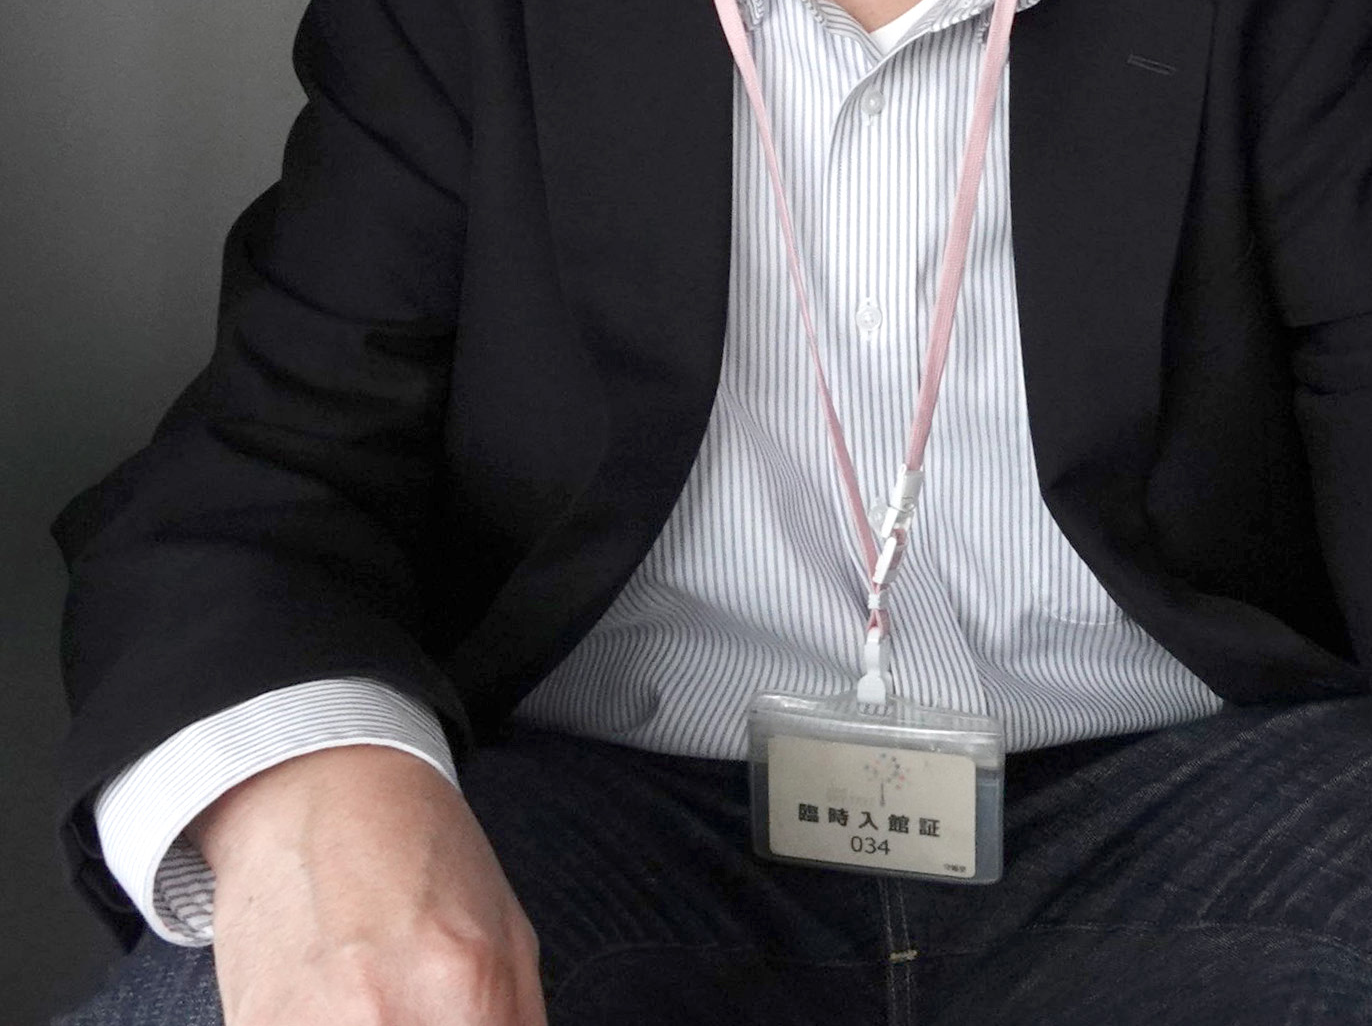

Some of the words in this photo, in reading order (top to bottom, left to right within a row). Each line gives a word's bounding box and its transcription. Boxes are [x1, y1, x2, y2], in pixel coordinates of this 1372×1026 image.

[797, 803, 941, 838] 臨時入館証
[850, 835, 891, 856] 034
